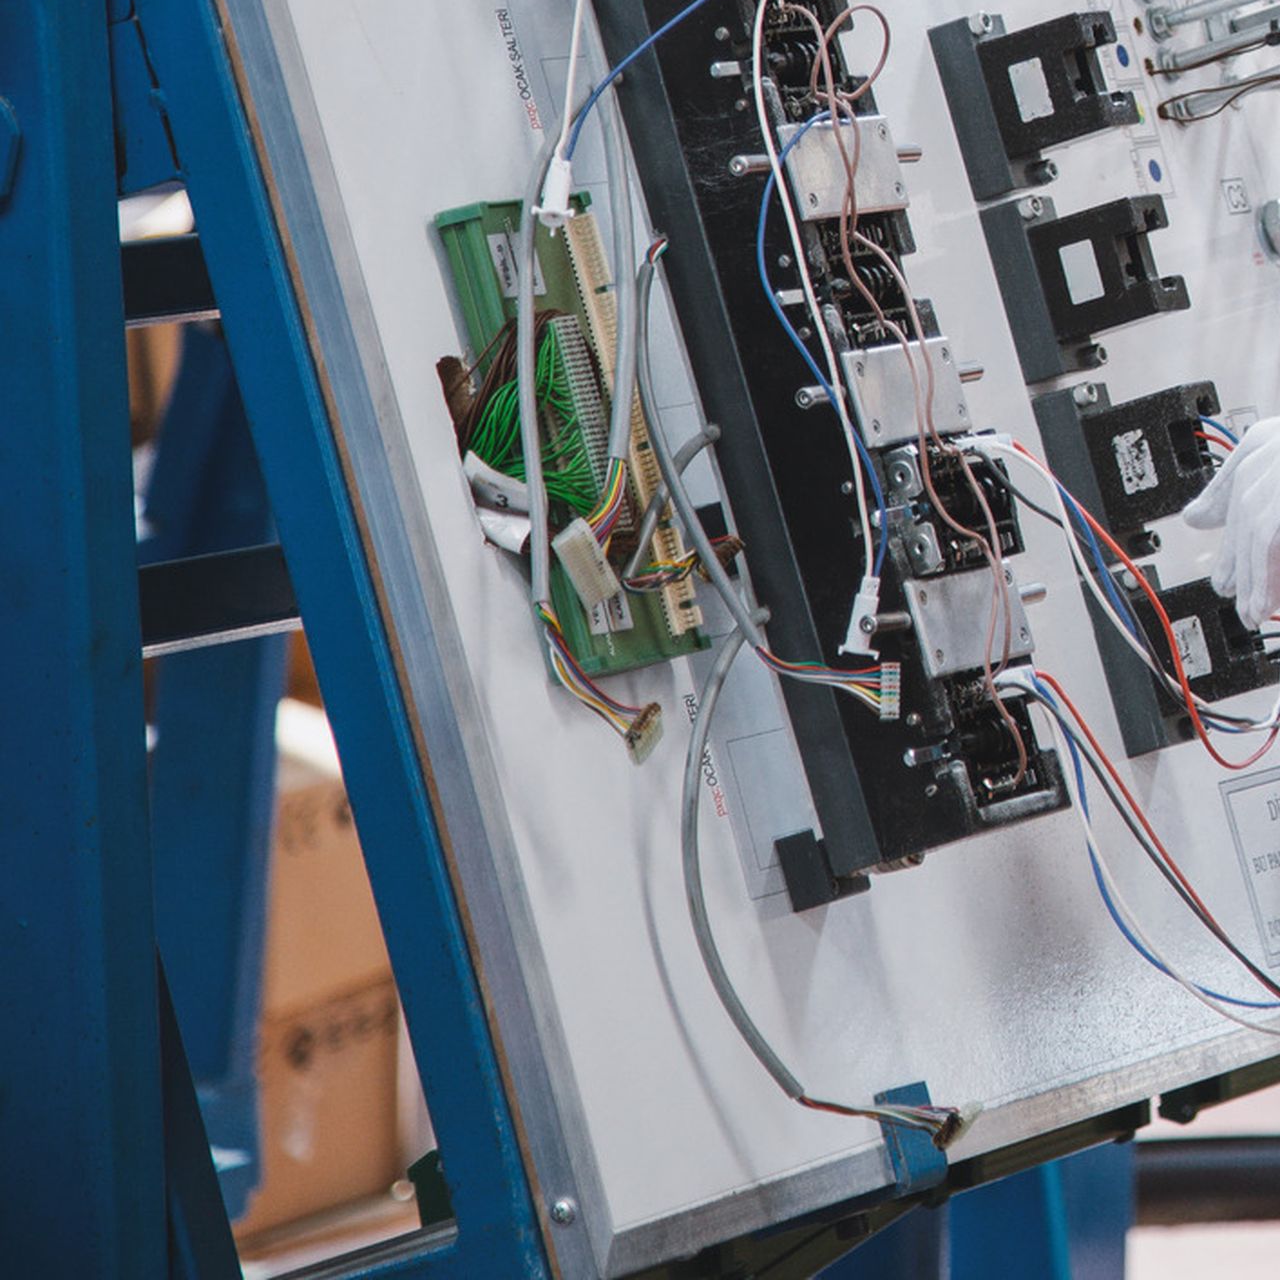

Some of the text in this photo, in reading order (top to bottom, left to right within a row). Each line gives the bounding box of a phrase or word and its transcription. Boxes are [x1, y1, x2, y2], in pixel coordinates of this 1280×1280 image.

[495, 8, 522, 62] ŞALTERİ
[512, 64, 531, 100] OCAK
[495, 493, 509, 508] 3
[1252, 854, 1268, 874] BU
